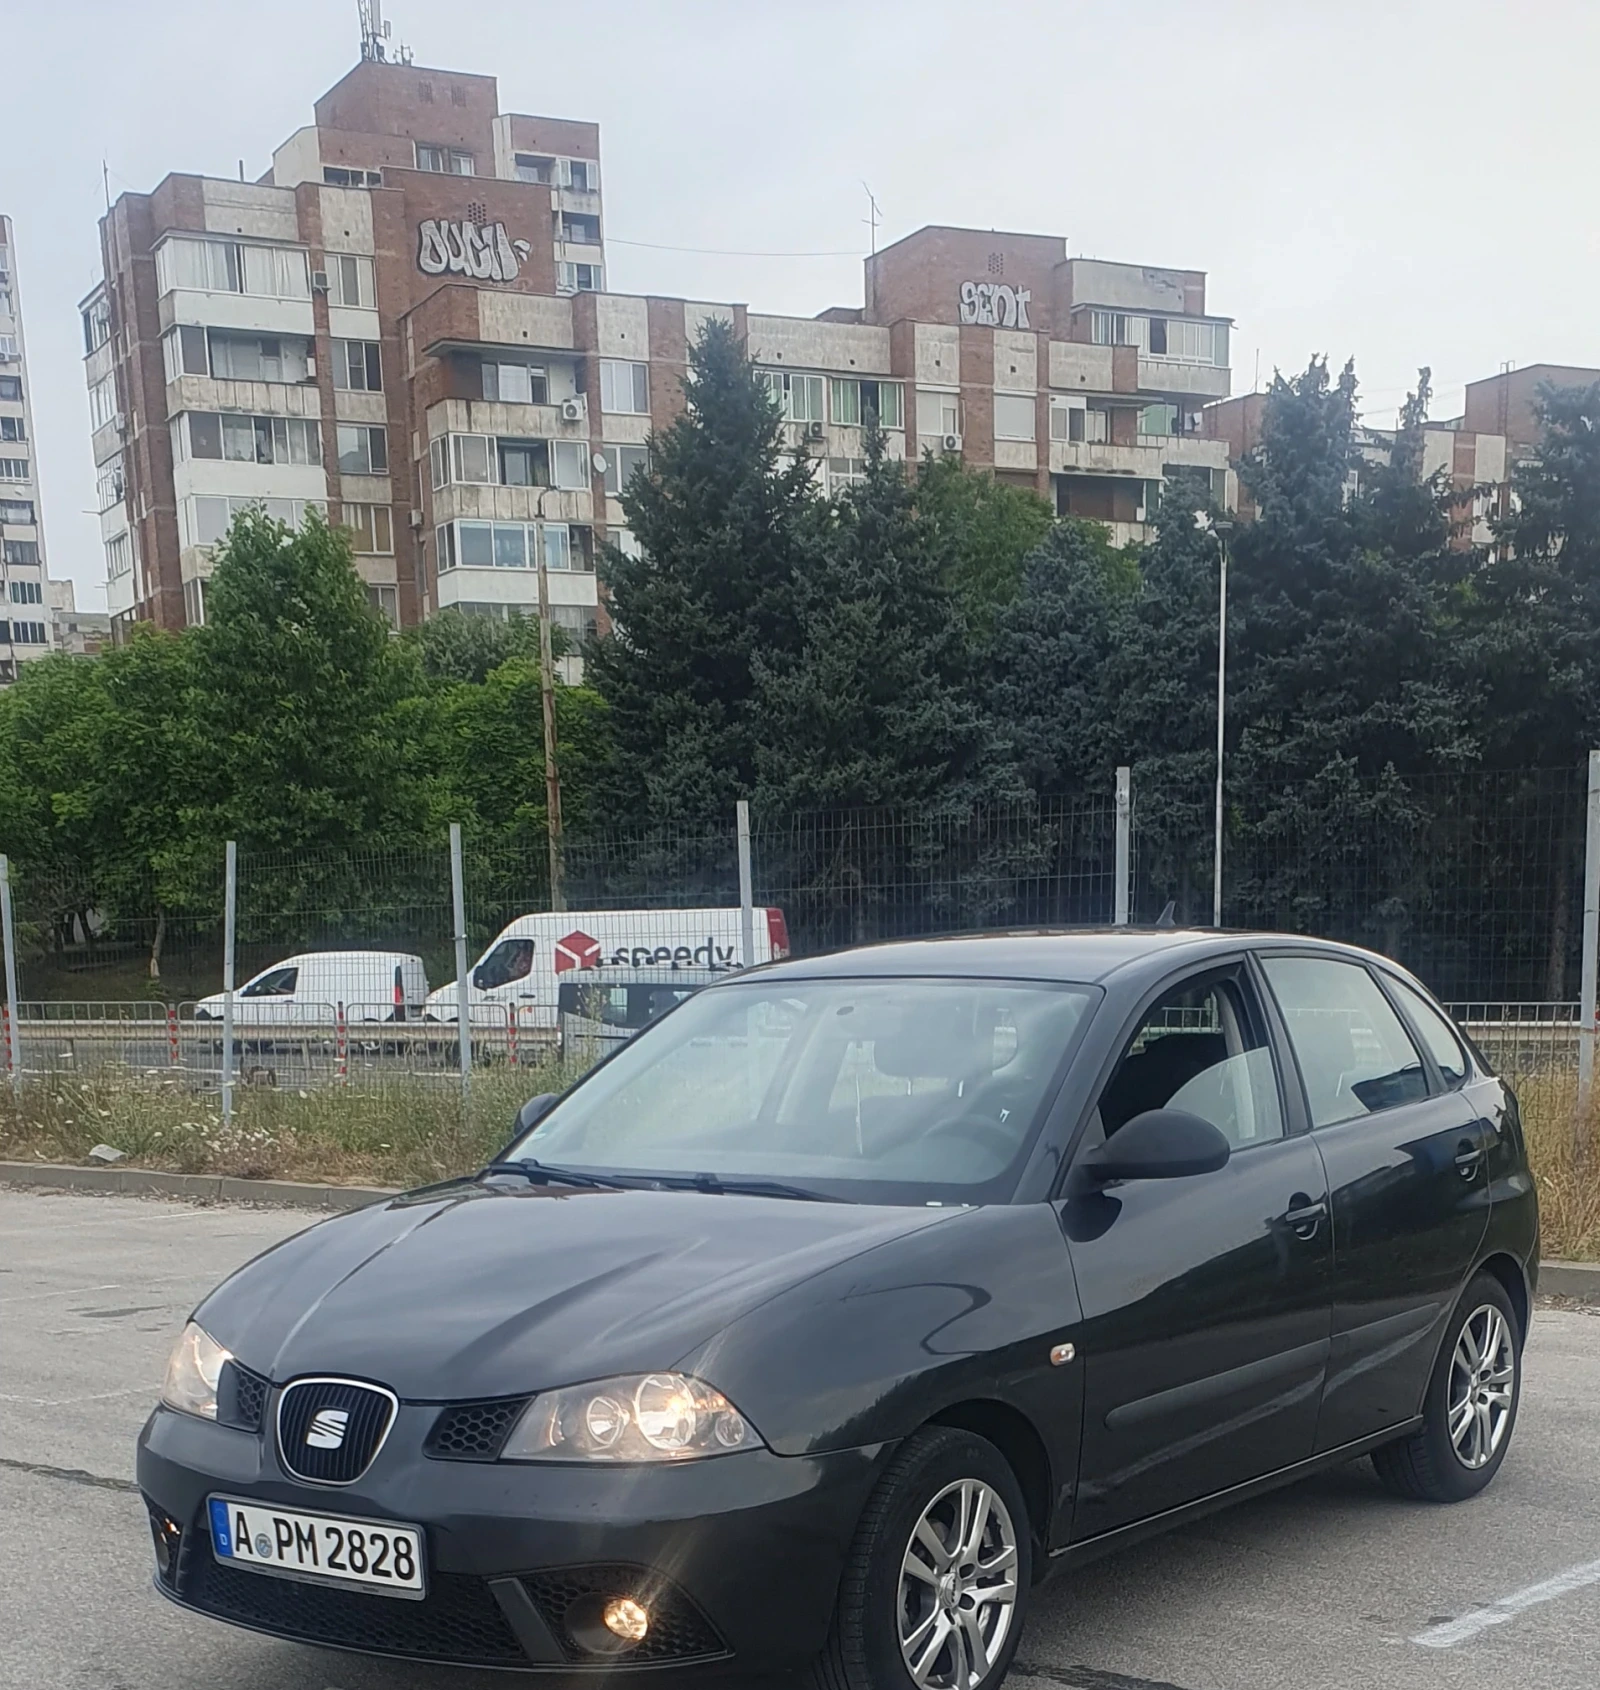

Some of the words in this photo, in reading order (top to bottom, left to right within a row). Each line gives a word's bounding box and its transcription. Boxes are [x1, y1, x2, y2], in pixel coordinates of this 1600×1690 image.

[615, 937, 735, 966] speedy
[235, 1511, 253, 1554] A
[273, 1517, 319, 1566] PM
[325, 1526, 415, 1581] 2828
